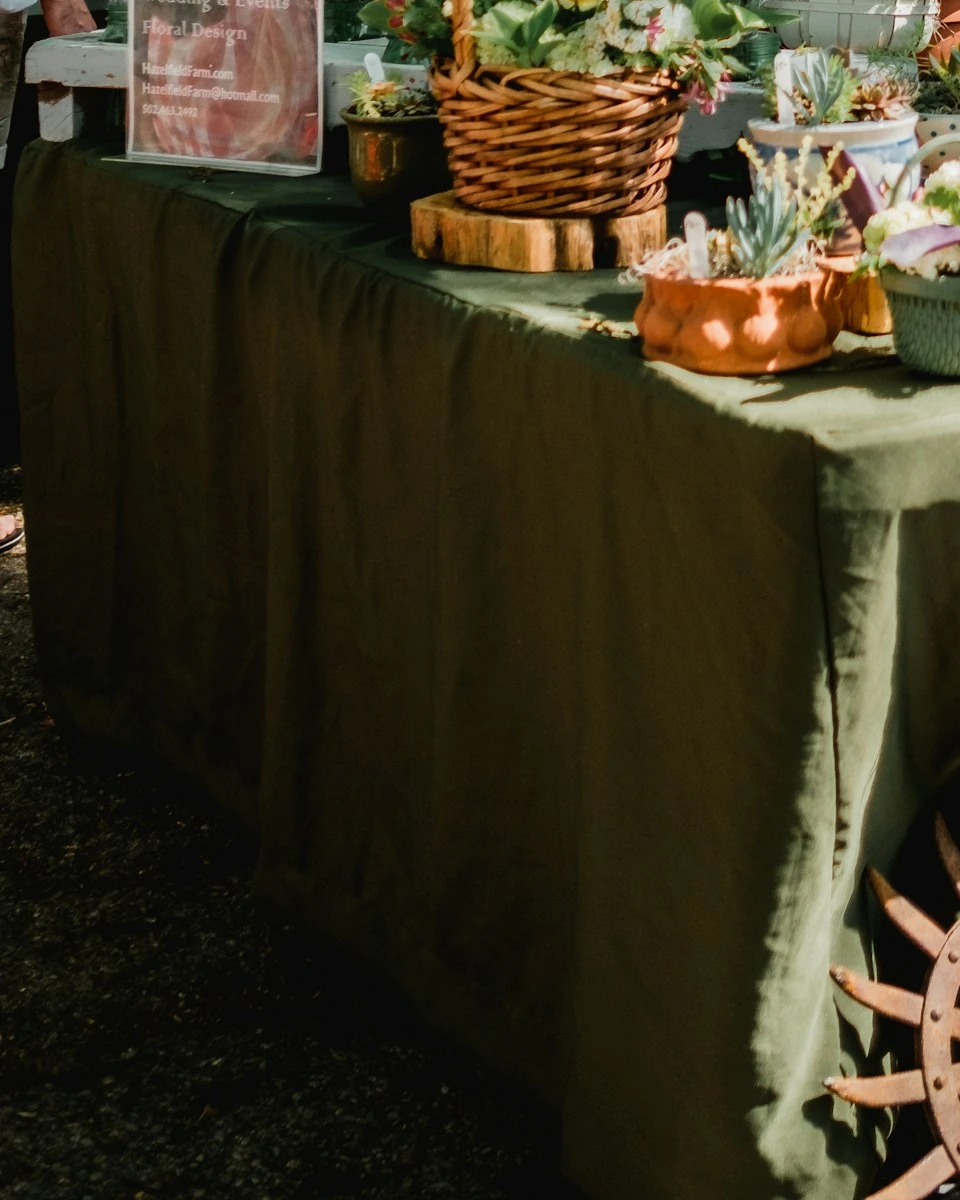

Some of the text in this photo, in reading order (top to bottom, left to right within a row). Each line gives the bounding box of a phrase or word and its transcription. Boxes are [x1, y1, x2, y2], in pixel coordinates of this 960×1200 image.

[142, 19, 247, 47] Floral Design
[142, 62, 234, 80] HazelfieldFarm.com
[142, 82, 280, 103] HazelfieldFarm@hotmail.com
